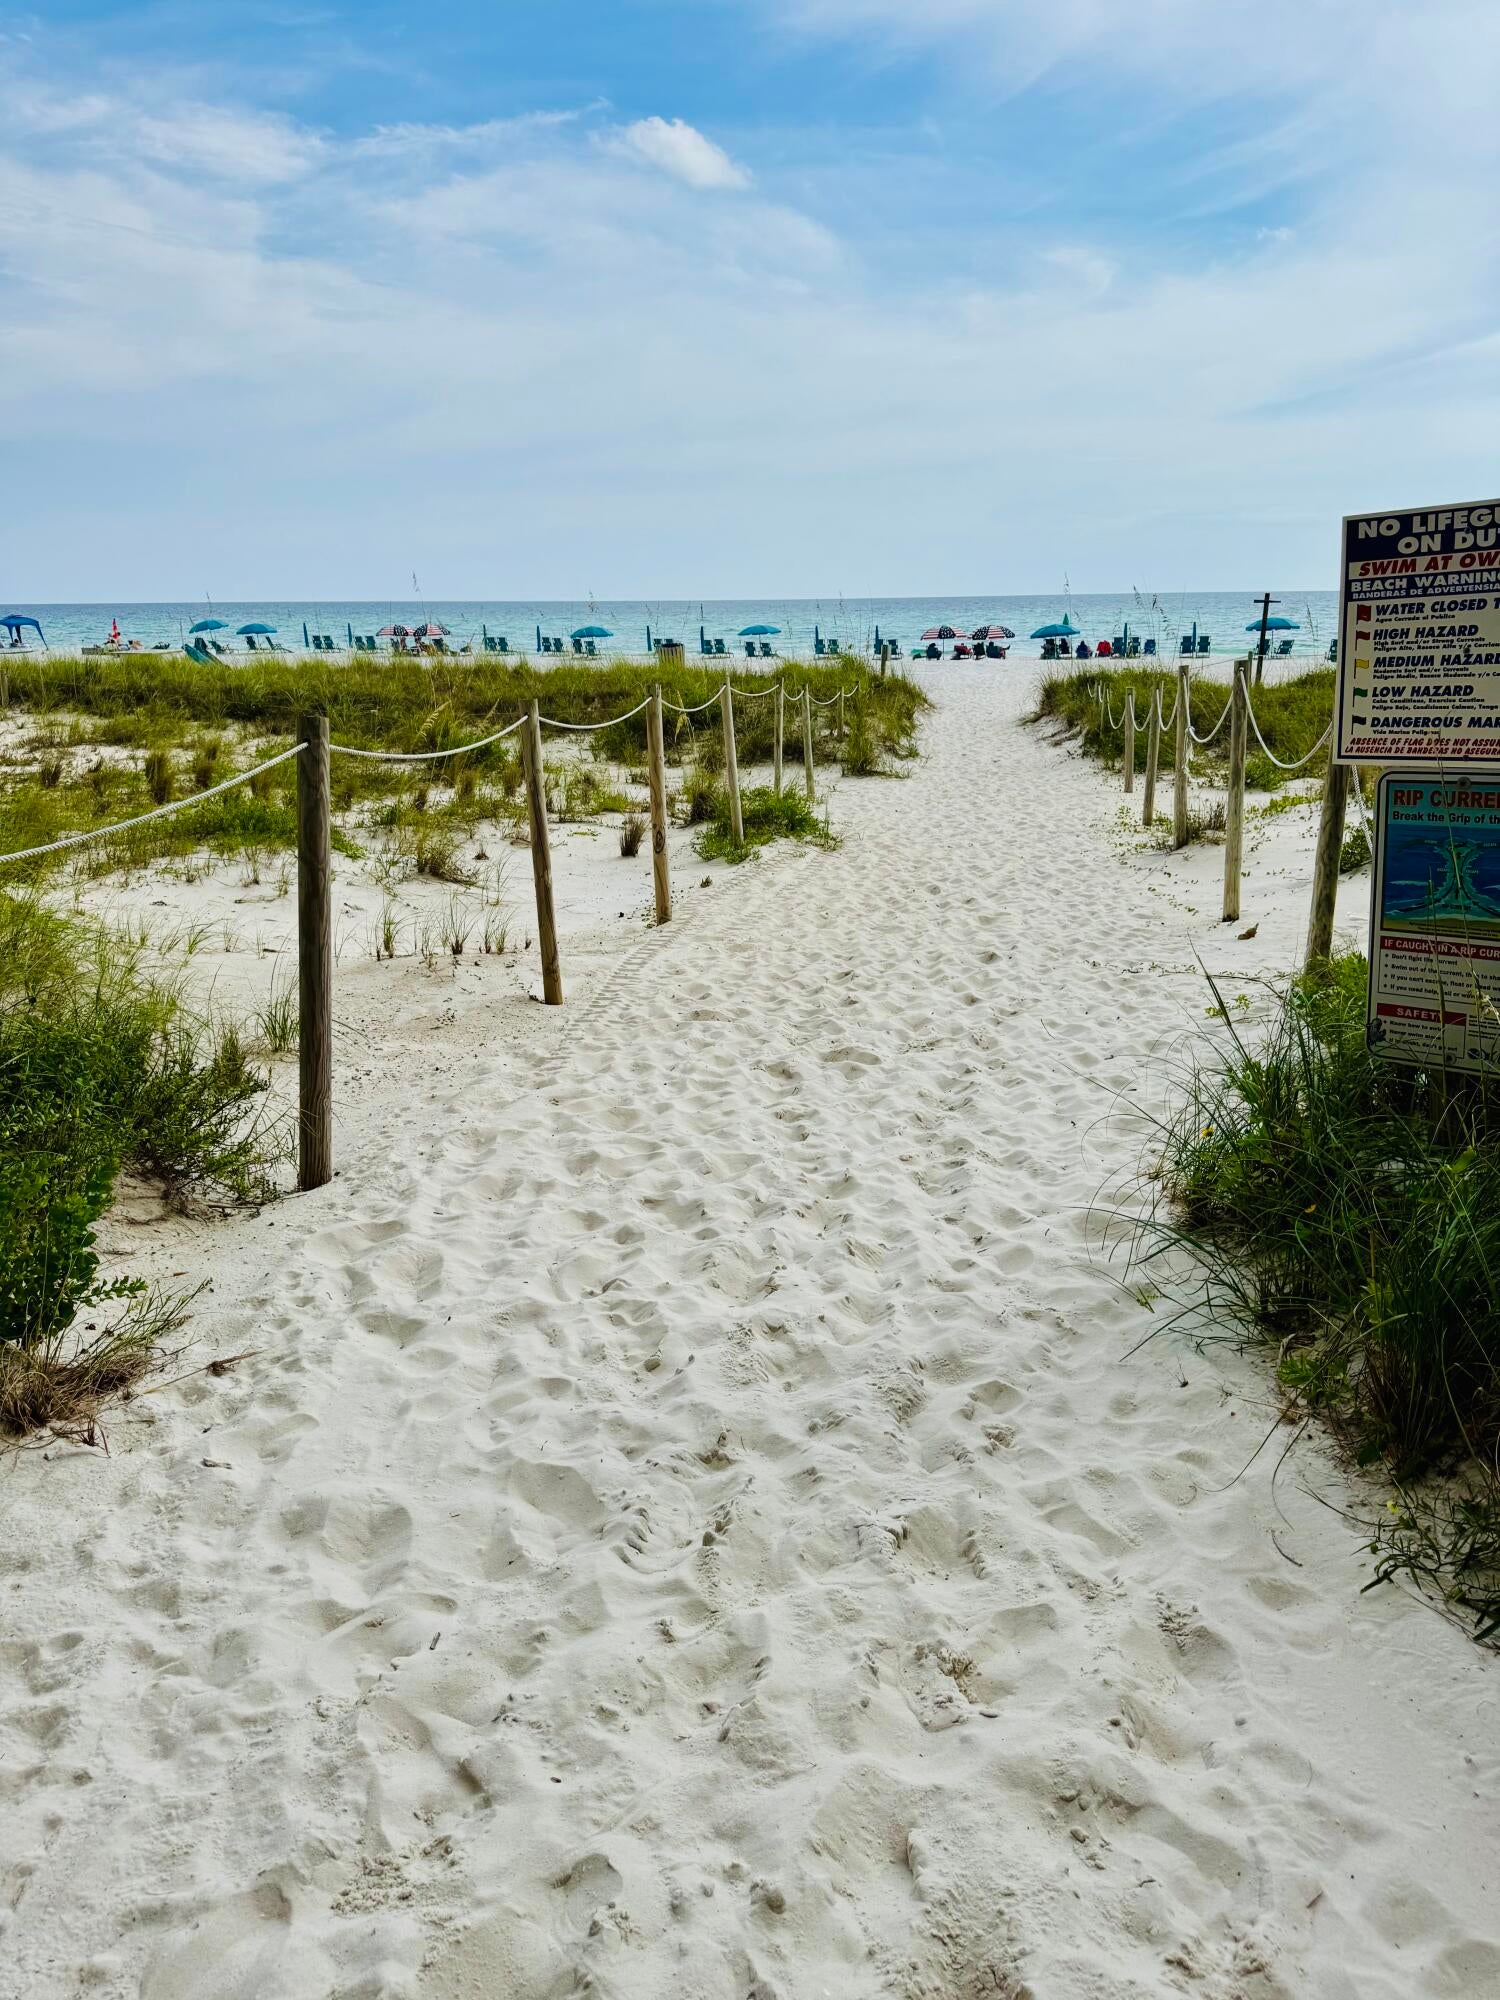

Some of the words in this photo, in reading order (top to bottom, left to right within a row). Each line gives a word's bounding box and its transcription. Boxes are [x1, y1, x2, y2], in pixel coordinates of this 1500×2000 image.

[1359, 519, 1400, 539] NO
[1412, 507, 1500, 533] LIFEG
[1398, 534, 1441, 554] ON
[1454, 528, 1500, 549] DU
[1359, 559, 1416, 576] SWIM
[1424, 556, 1452, 571] AT
[1460, 551, 1500, 568] OW
[1351, 578, 1407, 592] BEACH
[1414, 571, 1500, 588] WARNIN
[1353, 589, 1406, 599] BANDERAS
[1376, 603, 1425, 615] WATER
[1431, 599, 1487, 612] CLOSED
[1373, 628, 1410, 640] HIGH
[1415, 625, 1478, 638] HAZARD
[1374, 656, 1434, 667] MEDIUM
[1372, 686, 1406, 697] LOW
[1411, 685, 1474, 696] HAZARD
[1371, 717, 1462, 728] DANGEROUS
[1403, 738, 1424, 746] FLAG
[1394, 790, 1423, 805] RIP
[1431, 791, 1500, 808] CURRE
[1393, 811, 1423, 821] Break
[1428, 812, 1444, 821] the
[1449, 813, 1470, 824] Grip
[1474, 814, 1484, 823] of
[1385, 939, 1393, 947] IF
